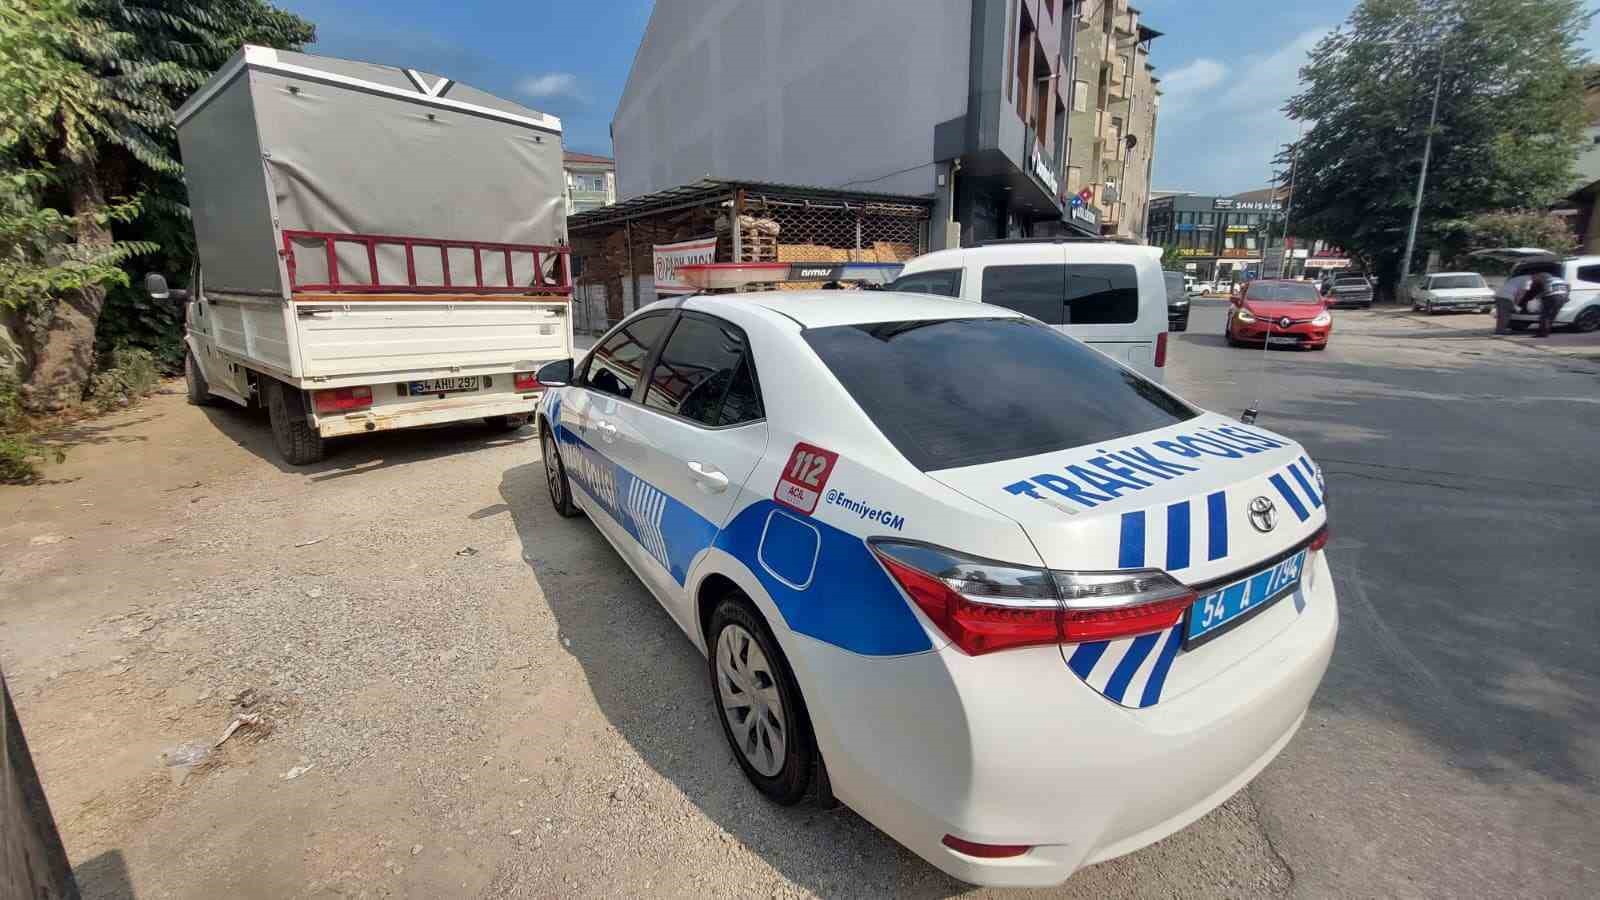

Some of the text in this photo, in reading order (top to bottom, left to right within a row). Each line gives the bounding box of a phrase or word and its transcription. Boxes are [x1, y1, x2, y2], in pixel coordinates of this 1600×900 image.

[434, 378, 455, 390] AHU
[789, 450, 828, 487] 112
[1003, 423, 1291, 507] TRAFİK POLİSİ
[825, 488, 905, 531] @EmniyetGM
[1201, 590, 1225, 628] 54
[1240, 578, 1252, 609] A
